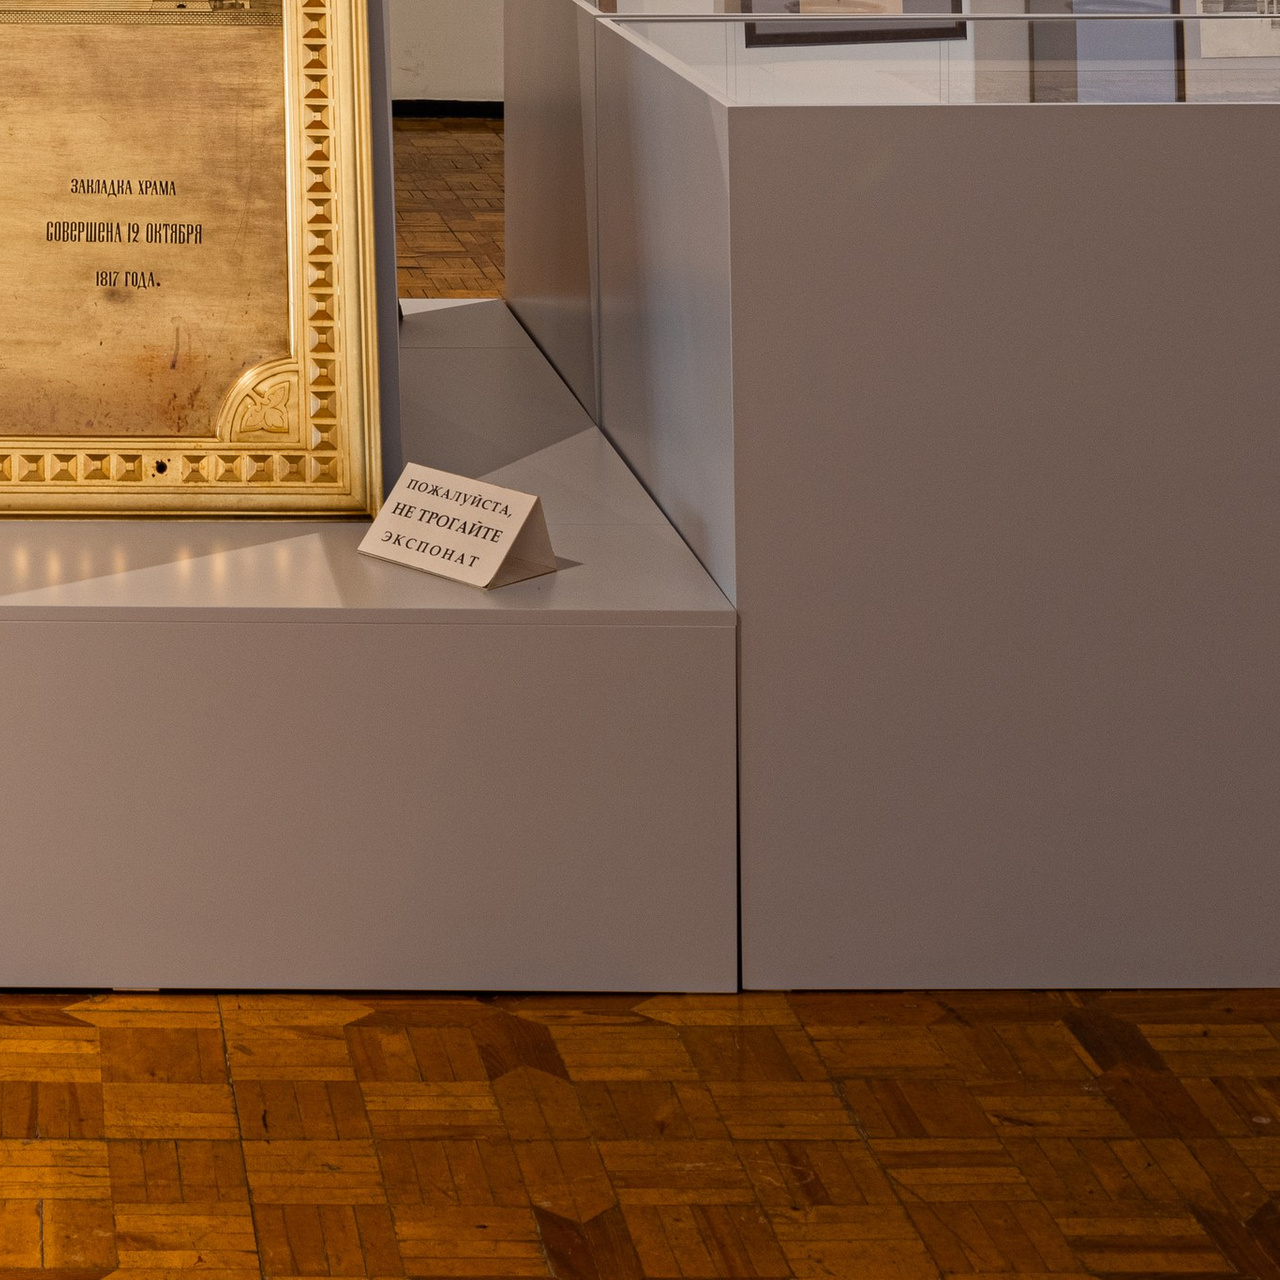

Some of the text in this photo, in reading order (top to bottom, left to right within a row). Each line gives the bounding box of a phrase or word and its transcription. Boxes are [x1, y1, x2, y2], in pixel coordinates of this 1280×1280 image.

[70, 178, 176, 197] ЗАКЛАДКА ХРАМА
[46, 221, 203, 245] СОВЕРШЕНА 12 ОКТЯБРЯ
[95, 271, 161, 290] 1817 ГОДА.
[406, 478, 512, 518] ПОЖАЛУЙСТА,
[391, 502, 504, 544] НЕ ТРОГАЙТЕ
[381, 530, 480, 568] ЭКСПОНАТ
